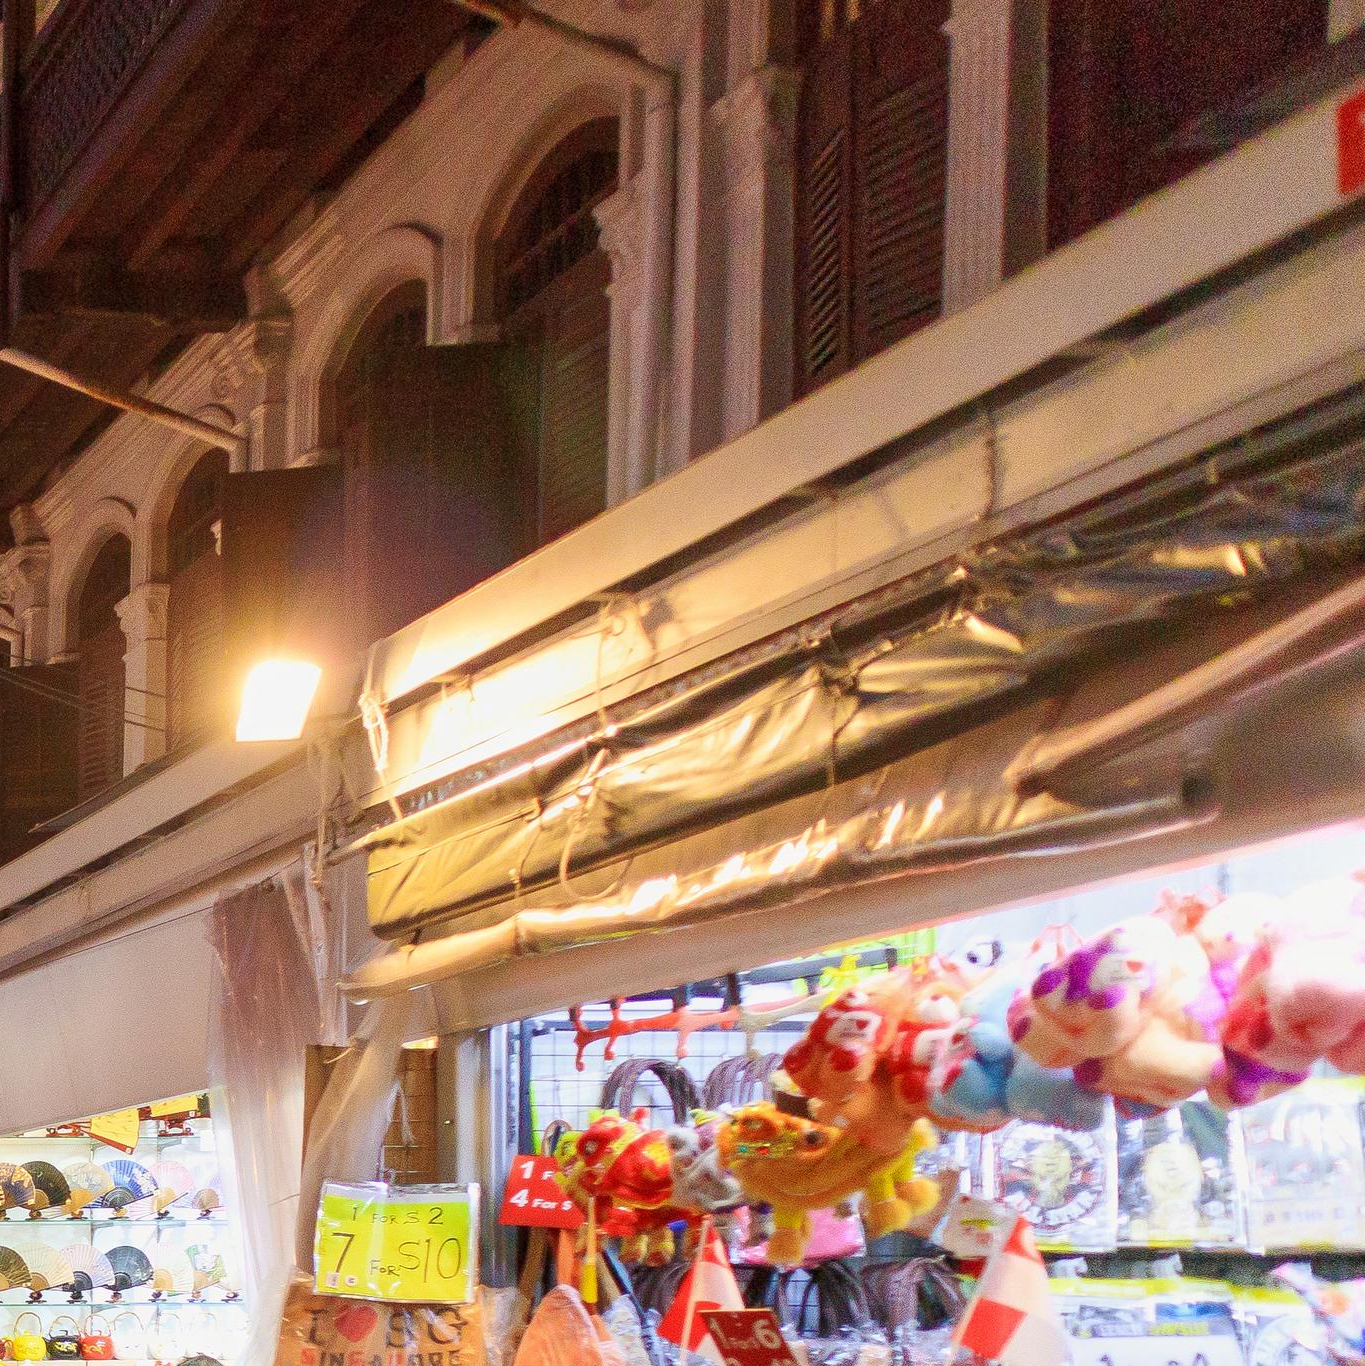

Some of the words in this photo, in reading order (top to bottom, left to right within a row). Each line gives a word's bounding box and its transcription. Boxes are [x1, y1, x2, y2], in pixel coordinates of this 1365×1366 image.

[519, 1160, 535, 1179] 1
[509, 1189, 529, 1208] 4
[352, 1207, 359, 1221] 1
[371, 1212, 398, 1225] FOR
[428, 1207, 445, 1226] 2
[332, 1232, 356, 1274] 7
